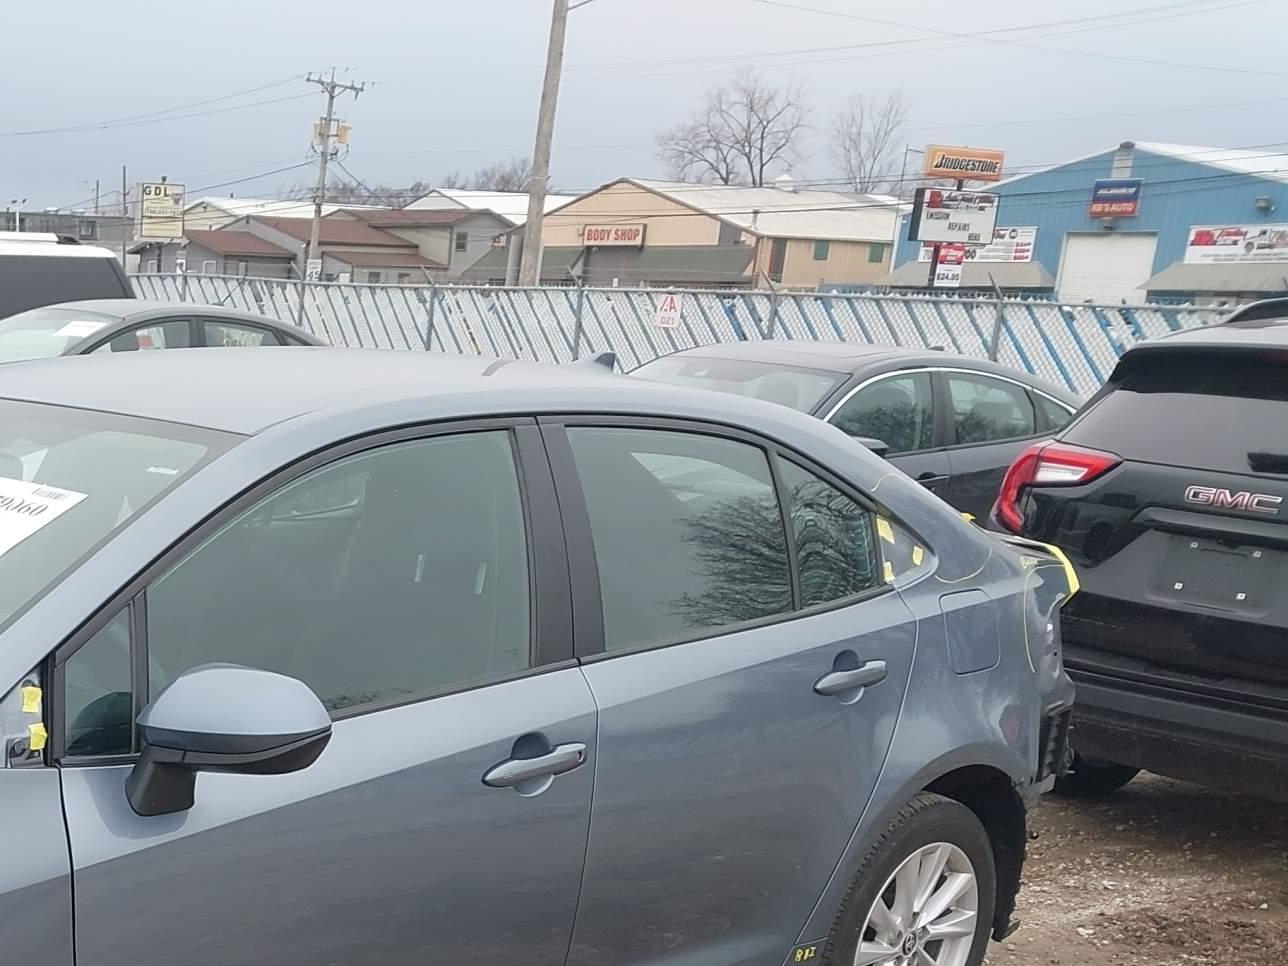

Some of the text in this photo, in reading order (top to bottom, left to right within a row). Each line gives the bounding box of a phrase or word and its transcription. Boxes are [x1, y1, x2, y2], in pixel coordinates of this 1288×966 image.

[934, 154, 999, 173] BRIDGESTONE
[143, 185, 170, 197] GDL
[1110, 202, 1134, 213] AUTO
[947, 222, 970, 231] REPAIRS
[587, 228, 640, 241] BODY SHOP
[936, 272, 959, 281] $24.95
[1185, 485, 1284, 514] GMC
